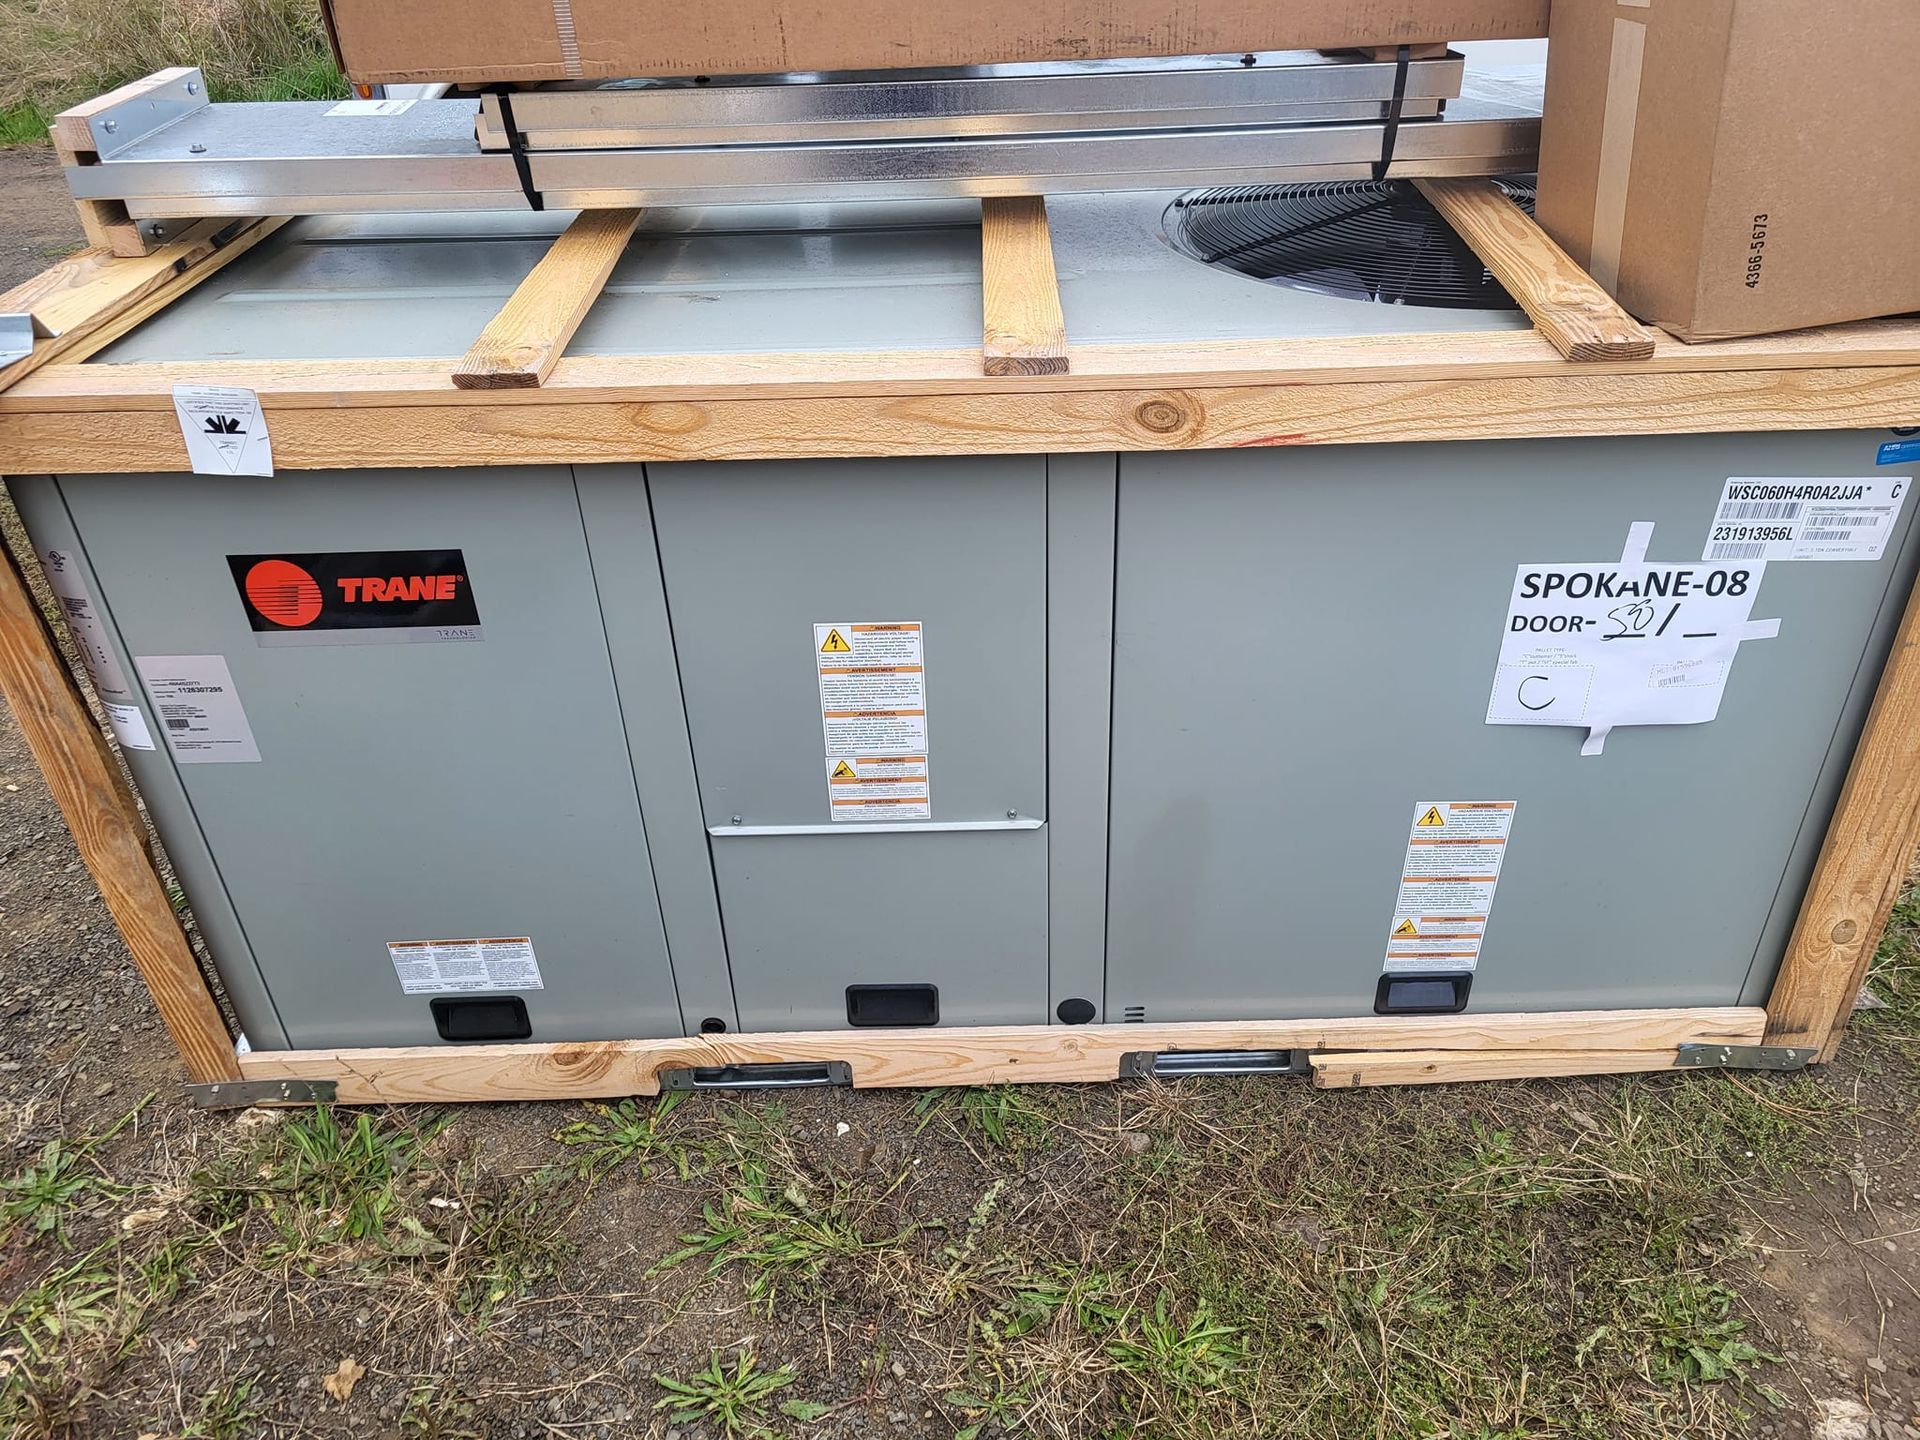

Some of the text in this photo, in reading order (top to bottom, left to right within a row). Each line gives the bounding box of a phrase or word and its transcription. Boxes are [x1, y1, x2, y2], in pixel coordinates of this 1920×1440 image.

[1745, 214, 1768, 288] 4366-5673
[1891, 484, 1902, 499] C
[1713, 526, 1793, 541] 231913956L
[1520, 569, 1750, 599] SPOKANE-08
[1511, 614, 1597, 633] DOOR-
[1517, 675, 1556, 711] C
